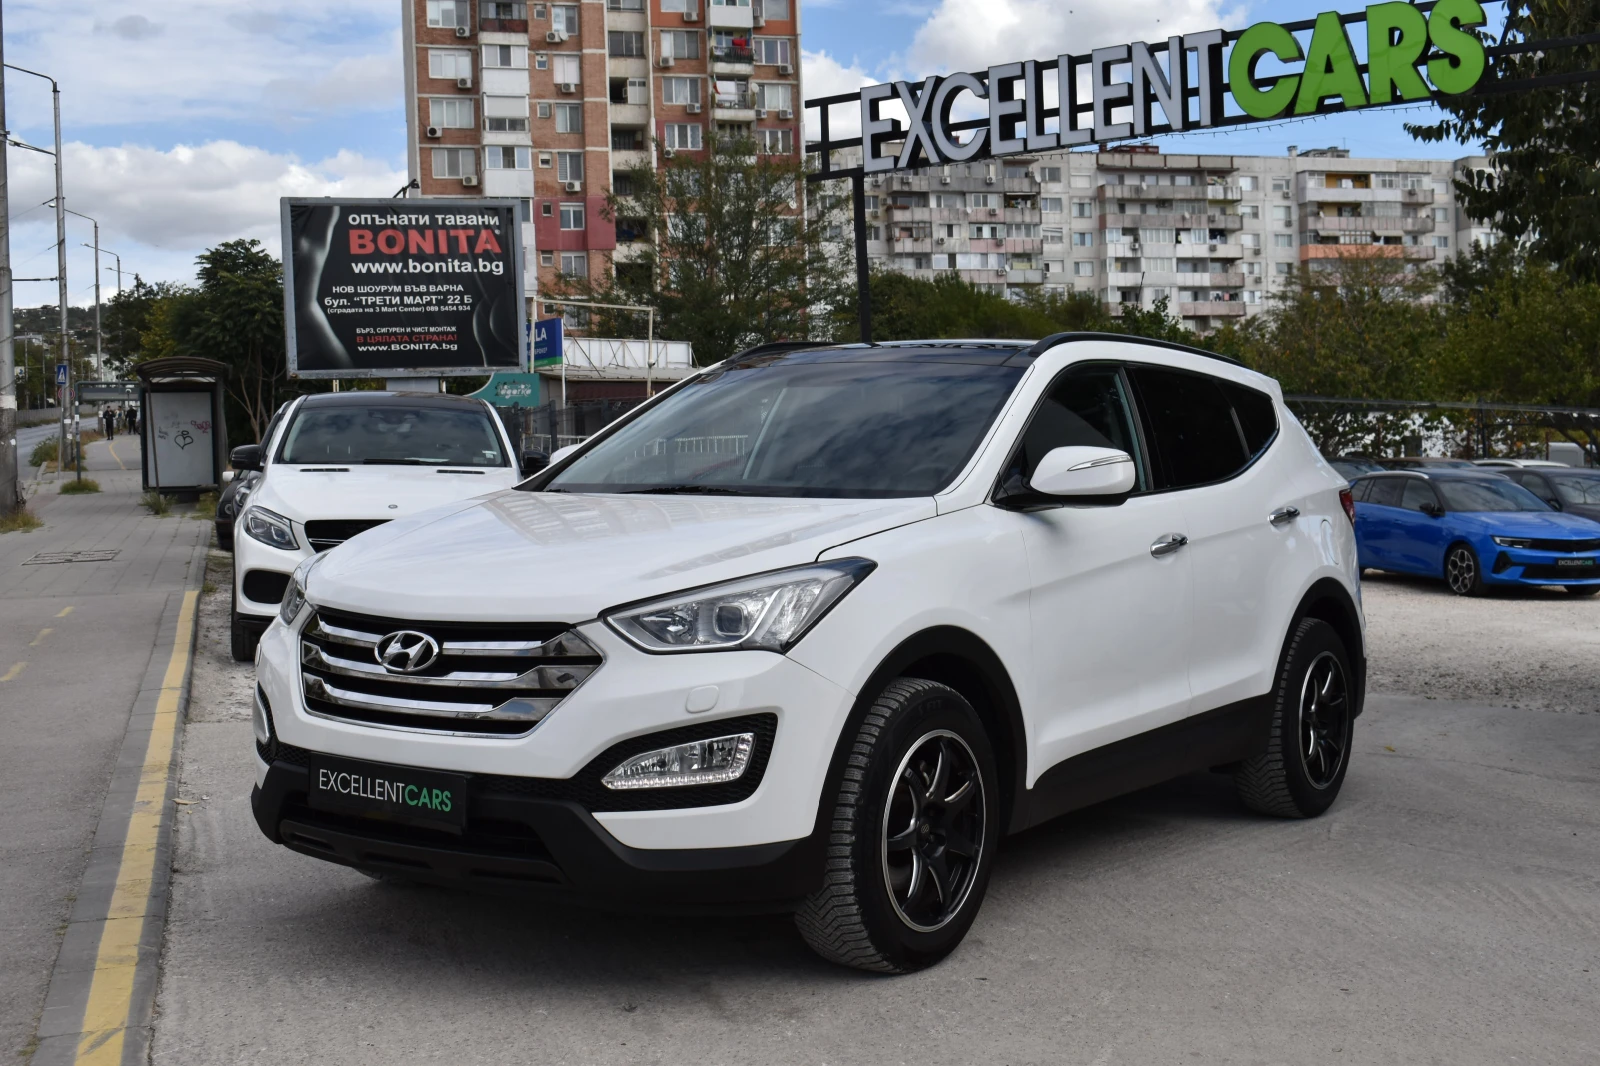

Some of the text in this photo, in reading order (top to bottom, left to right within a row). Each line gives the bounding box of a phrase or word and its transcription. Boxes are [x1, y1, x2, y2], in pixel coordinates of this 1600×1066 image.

[348, 213, 500, 226] опънати тавани
[348, 229, 502, 255] BONITA
[351, 258, 504, 276] www.bonita.bg
[332, 284, 465, 293] НОВ ШОУРУМ ВЪВ ВАРНА
[324, 297, 351, 308] бул.
[447, 295, 461, 304] 22
[464, 295, 472, 304] Б
[399, 305, 425, 313] Center)
[367, 335, 410, 344] ЦЯЛАТА
[412, 334, 458, 342] СТРАНА!
[357, 343, 458, 352] www.BONITA.bg
[319, 768, 452, 812] EXCELLENTCARS
